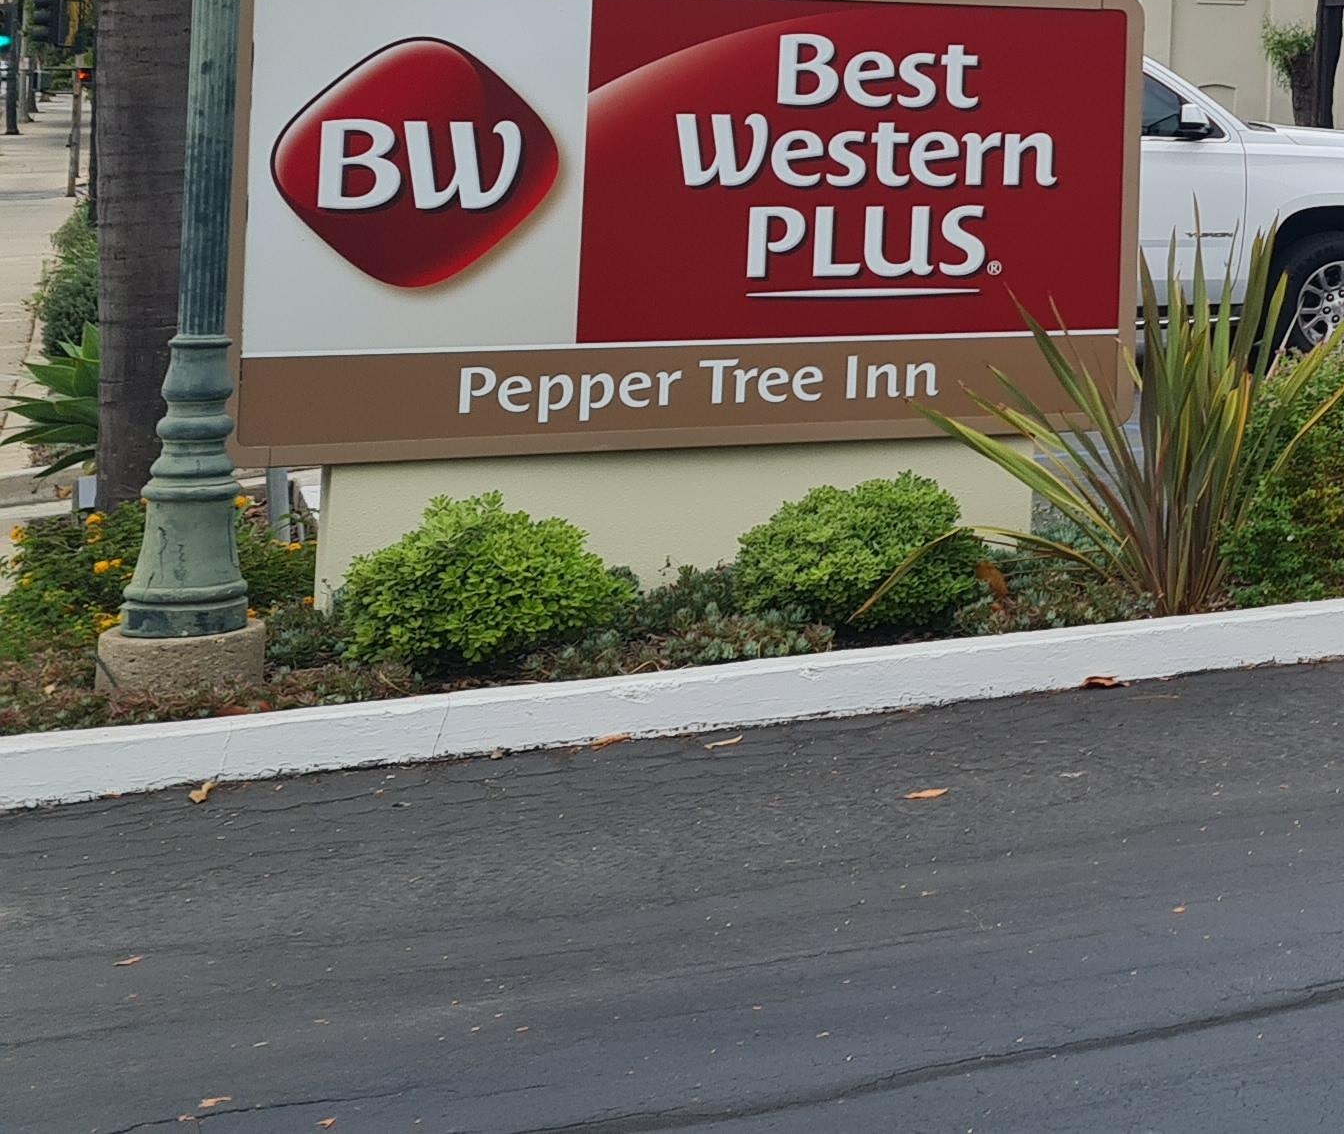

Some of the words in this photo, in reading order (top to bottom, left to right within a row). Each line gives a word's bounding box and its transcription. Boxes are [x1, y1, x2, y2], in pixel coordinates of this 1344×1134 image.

[777, 33, 979, 109] Best
[317, 118, 522, 210] BW
[675, 113, 1058, 187] Western
[458, 366, 683, 423] Pepper
[699, 358, 824, 404] Tree
[845, 355, 939, 399] Inn
